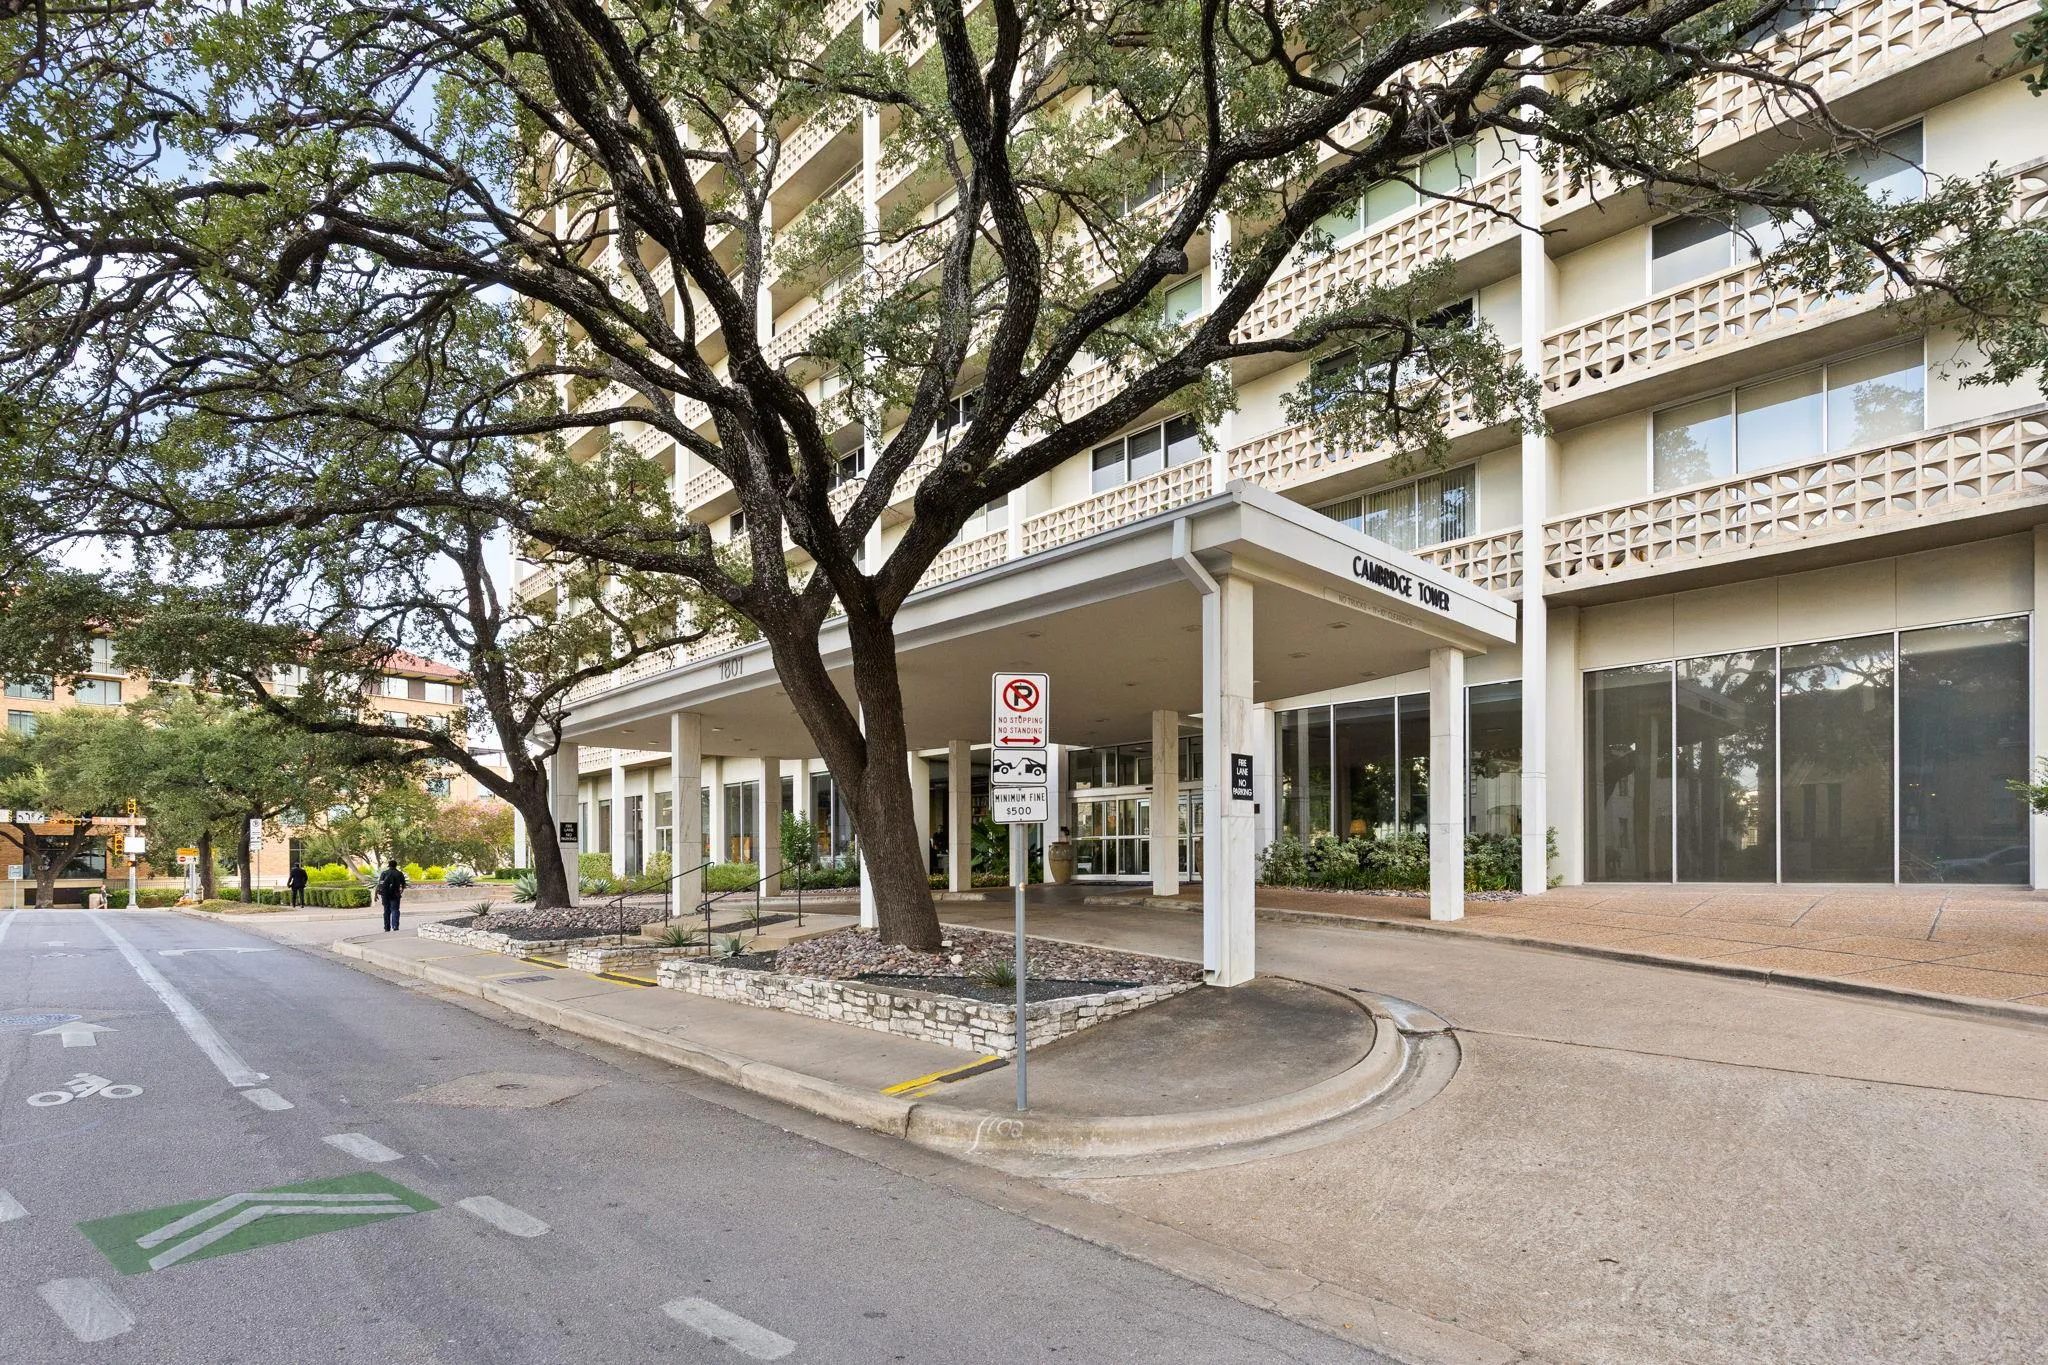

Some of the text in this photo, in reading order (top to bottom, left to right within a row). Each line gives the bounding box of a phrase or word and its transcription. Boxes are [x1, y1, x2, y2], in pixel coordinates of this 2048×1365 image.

[1352, 555, 1450, 611] CAMBRIDGE TOWER
[719, 656, 743, 680] 1801
[1009, 716, 1043, 724] STOPPING
[1236, 767, 1248, 776] LANE
[1238, 779, 1247, 787] NO
[1232, 788, 1252, 796] PARKING
[995, 792, 1046, 802] MINIMUM FINE
[1006, 806, 1032, 816] $500
